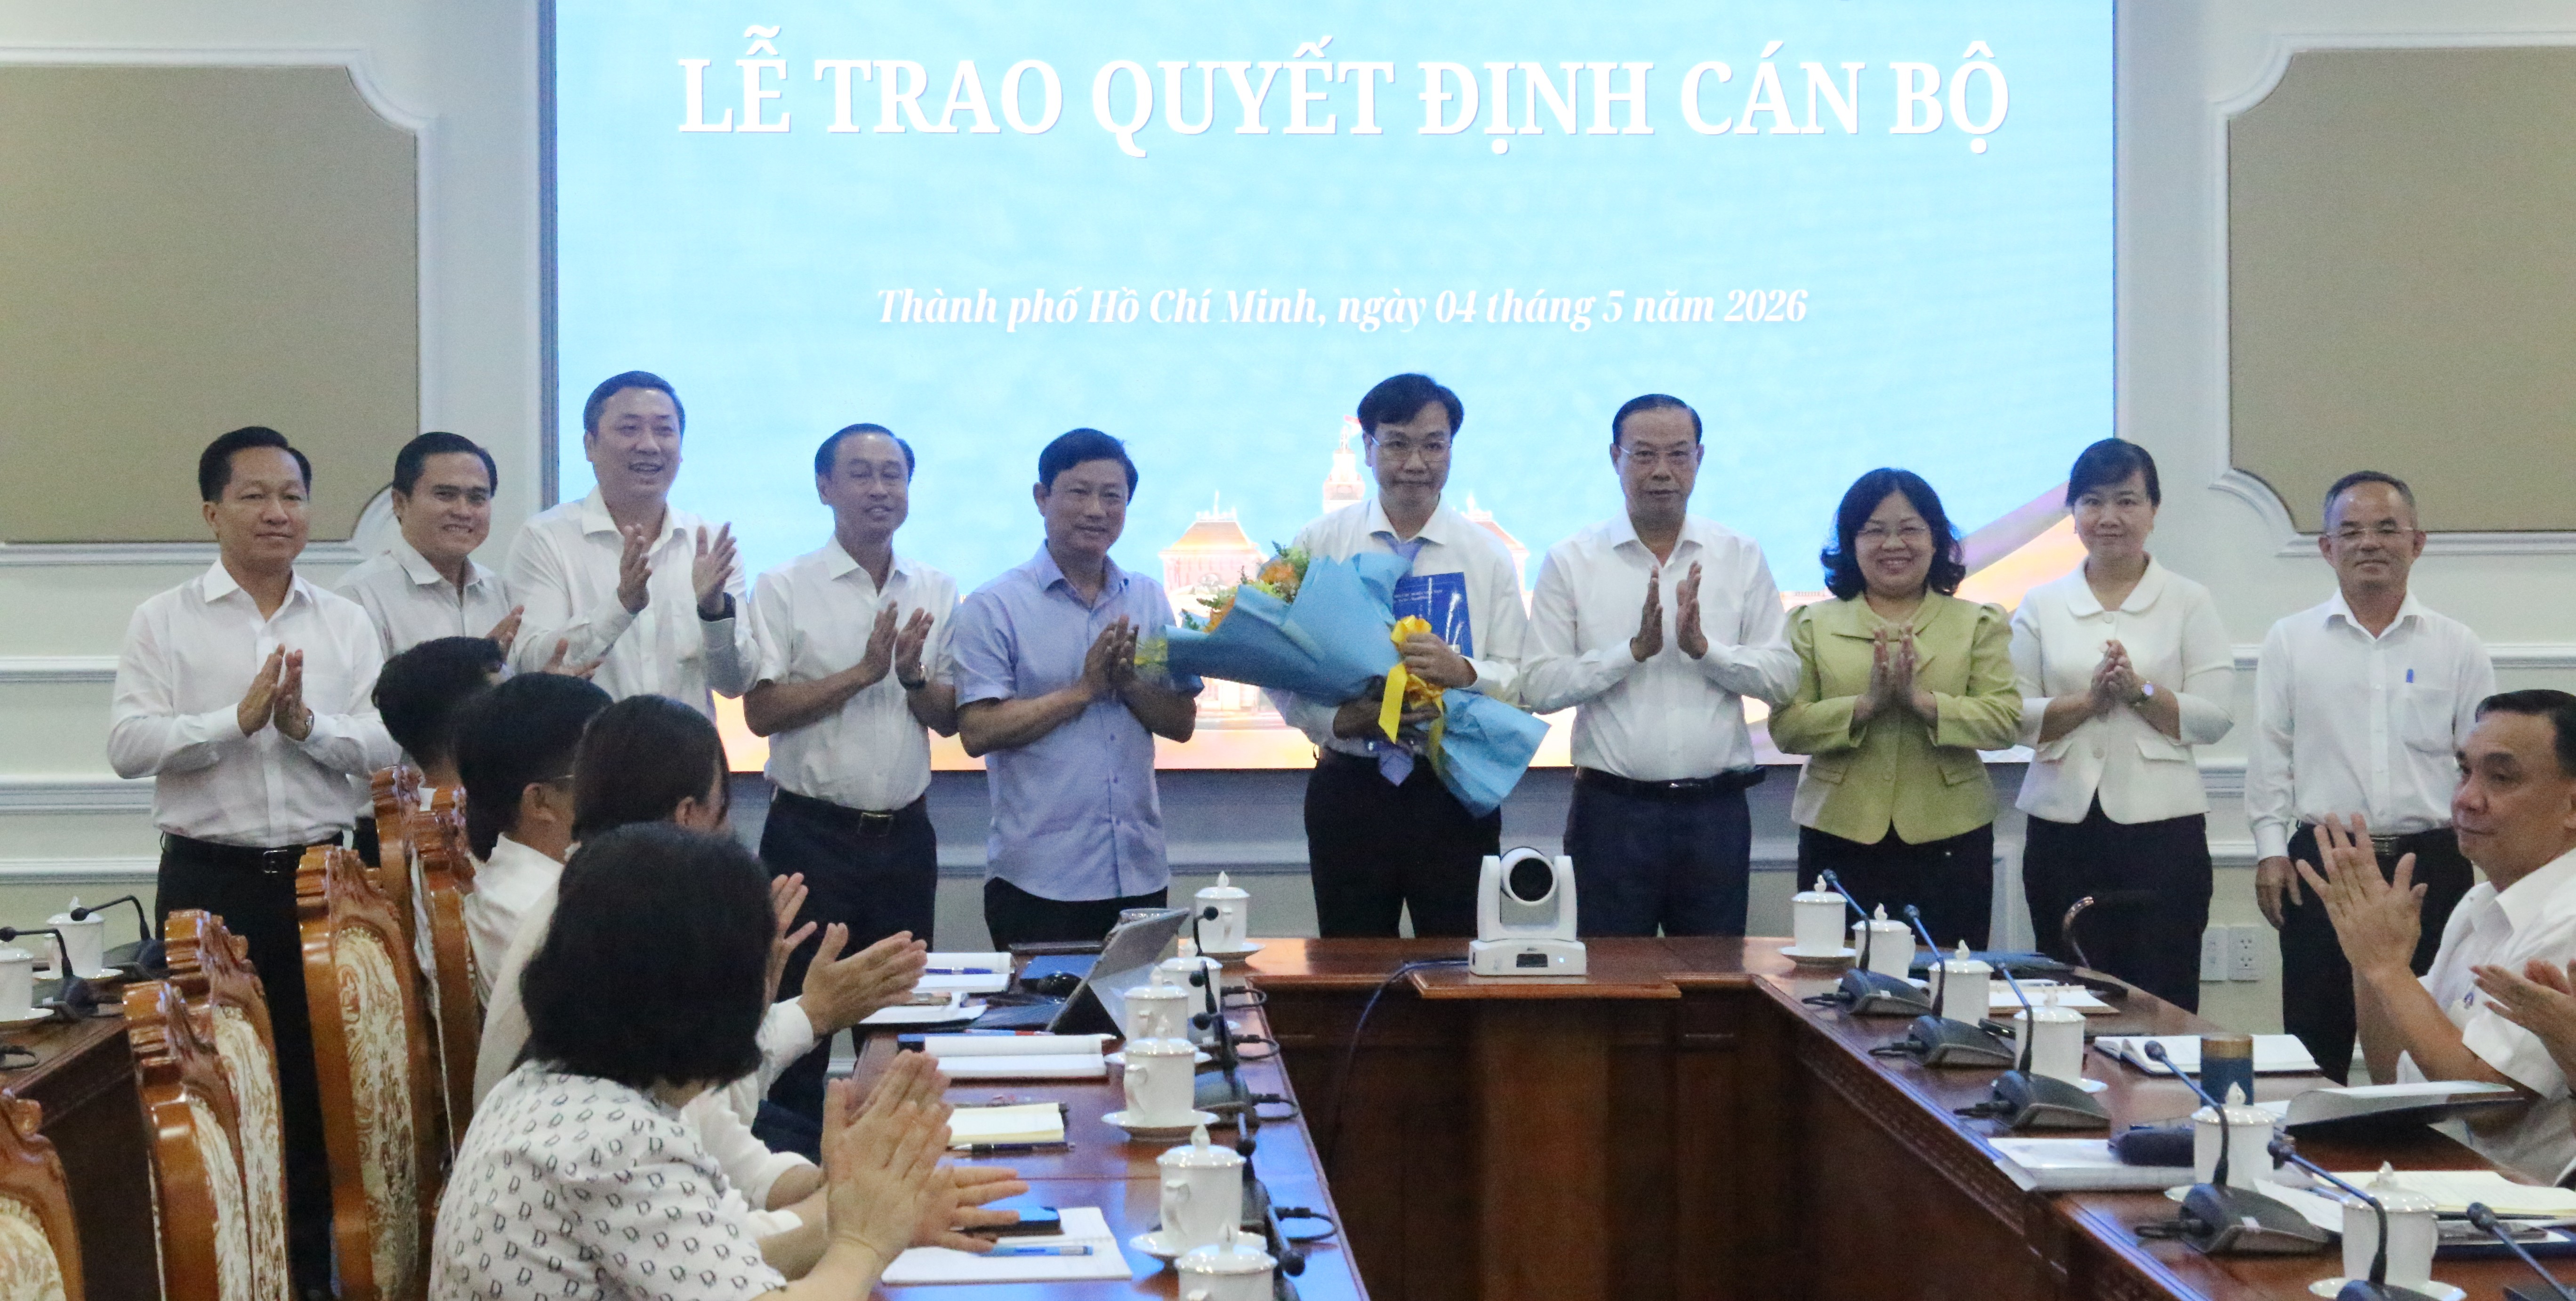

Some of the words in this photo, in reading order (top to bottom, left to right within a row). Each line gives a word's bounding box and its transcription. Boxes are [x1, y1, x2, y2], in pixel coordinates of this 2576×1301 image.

[677, 24, 790, 133] LỄ
[814, 59, 1063, 134] TRAO
[1092, 35, 1394, 158] QUYẾT
[1417, 62, 1654, 154] ĐỊNH
[1681, 40, 1866, 135] CÁN
[1889, 40, 2009, 154] BỘ
[877, 288, 997, 323] Thành
[1006, 286, 1083, 333] phố
[1088, 286, 1139, 323] Hồ
[1150, 288, 1213, 323] Chí
[1220, 288, 1326, 326] Minh,
[1337, 288, 1427, 332] ngày
[1435, 289, 1477, 323] 04
[1486, 288, 1597, 332] tháng
[1602, 289, 1625, 322] 5
[1633, 289, 1715, 323] năm
[1723, 289, 1809, 322] 2026
